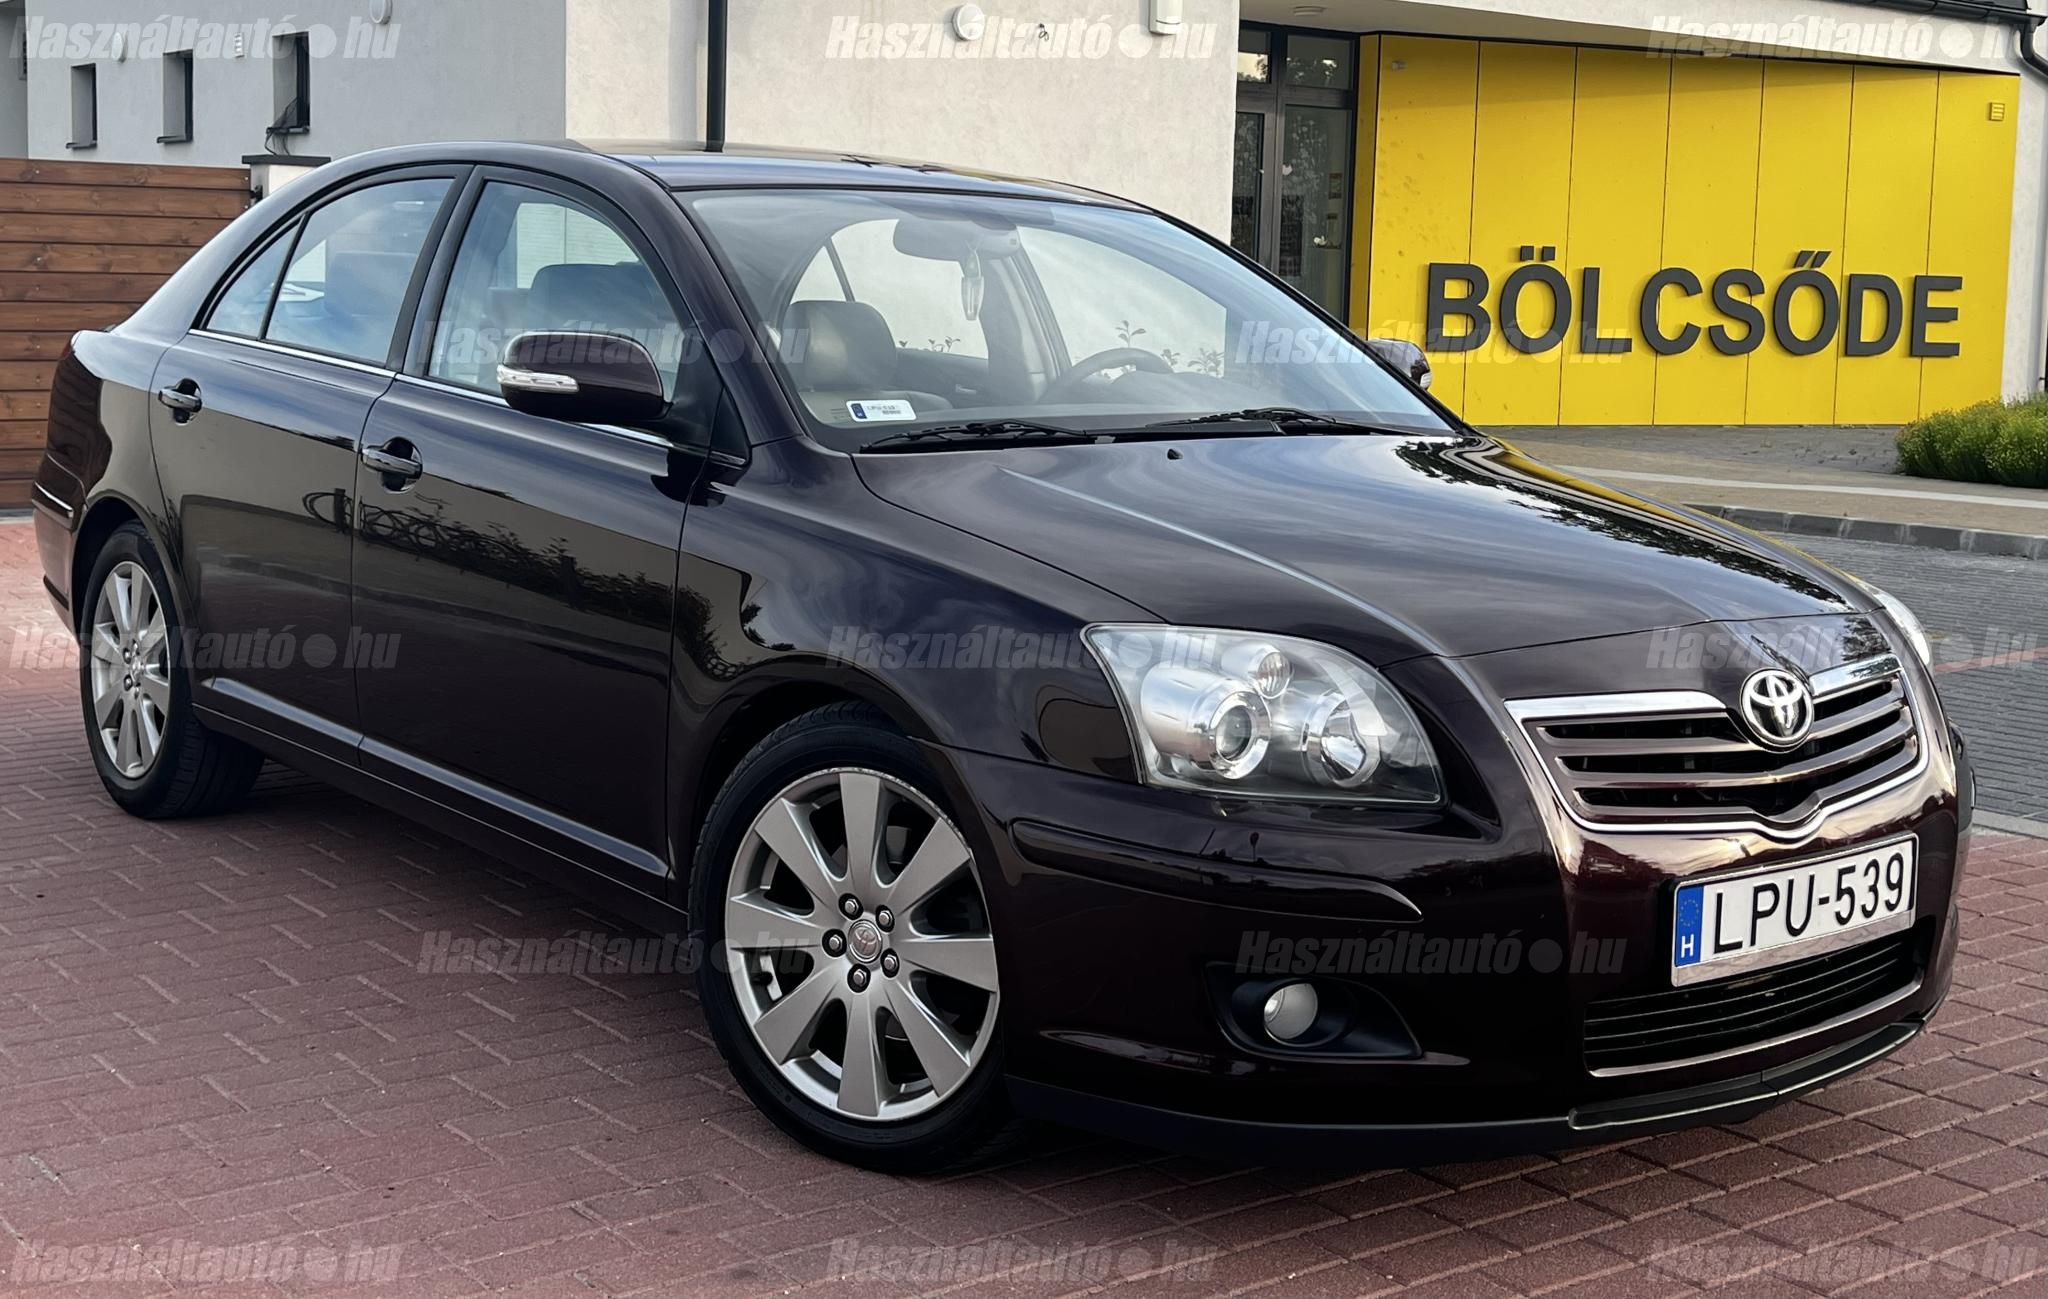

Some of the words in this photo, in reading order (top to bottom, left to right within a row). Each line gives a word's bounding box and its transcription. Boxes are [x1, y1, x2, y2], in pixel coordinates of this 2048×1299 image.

[1426, 246, 1963, 357] BÖLCSŐDE
[1681, 934, 1695, 958] H
[1714, 852, 1904, 953] LPU-539
